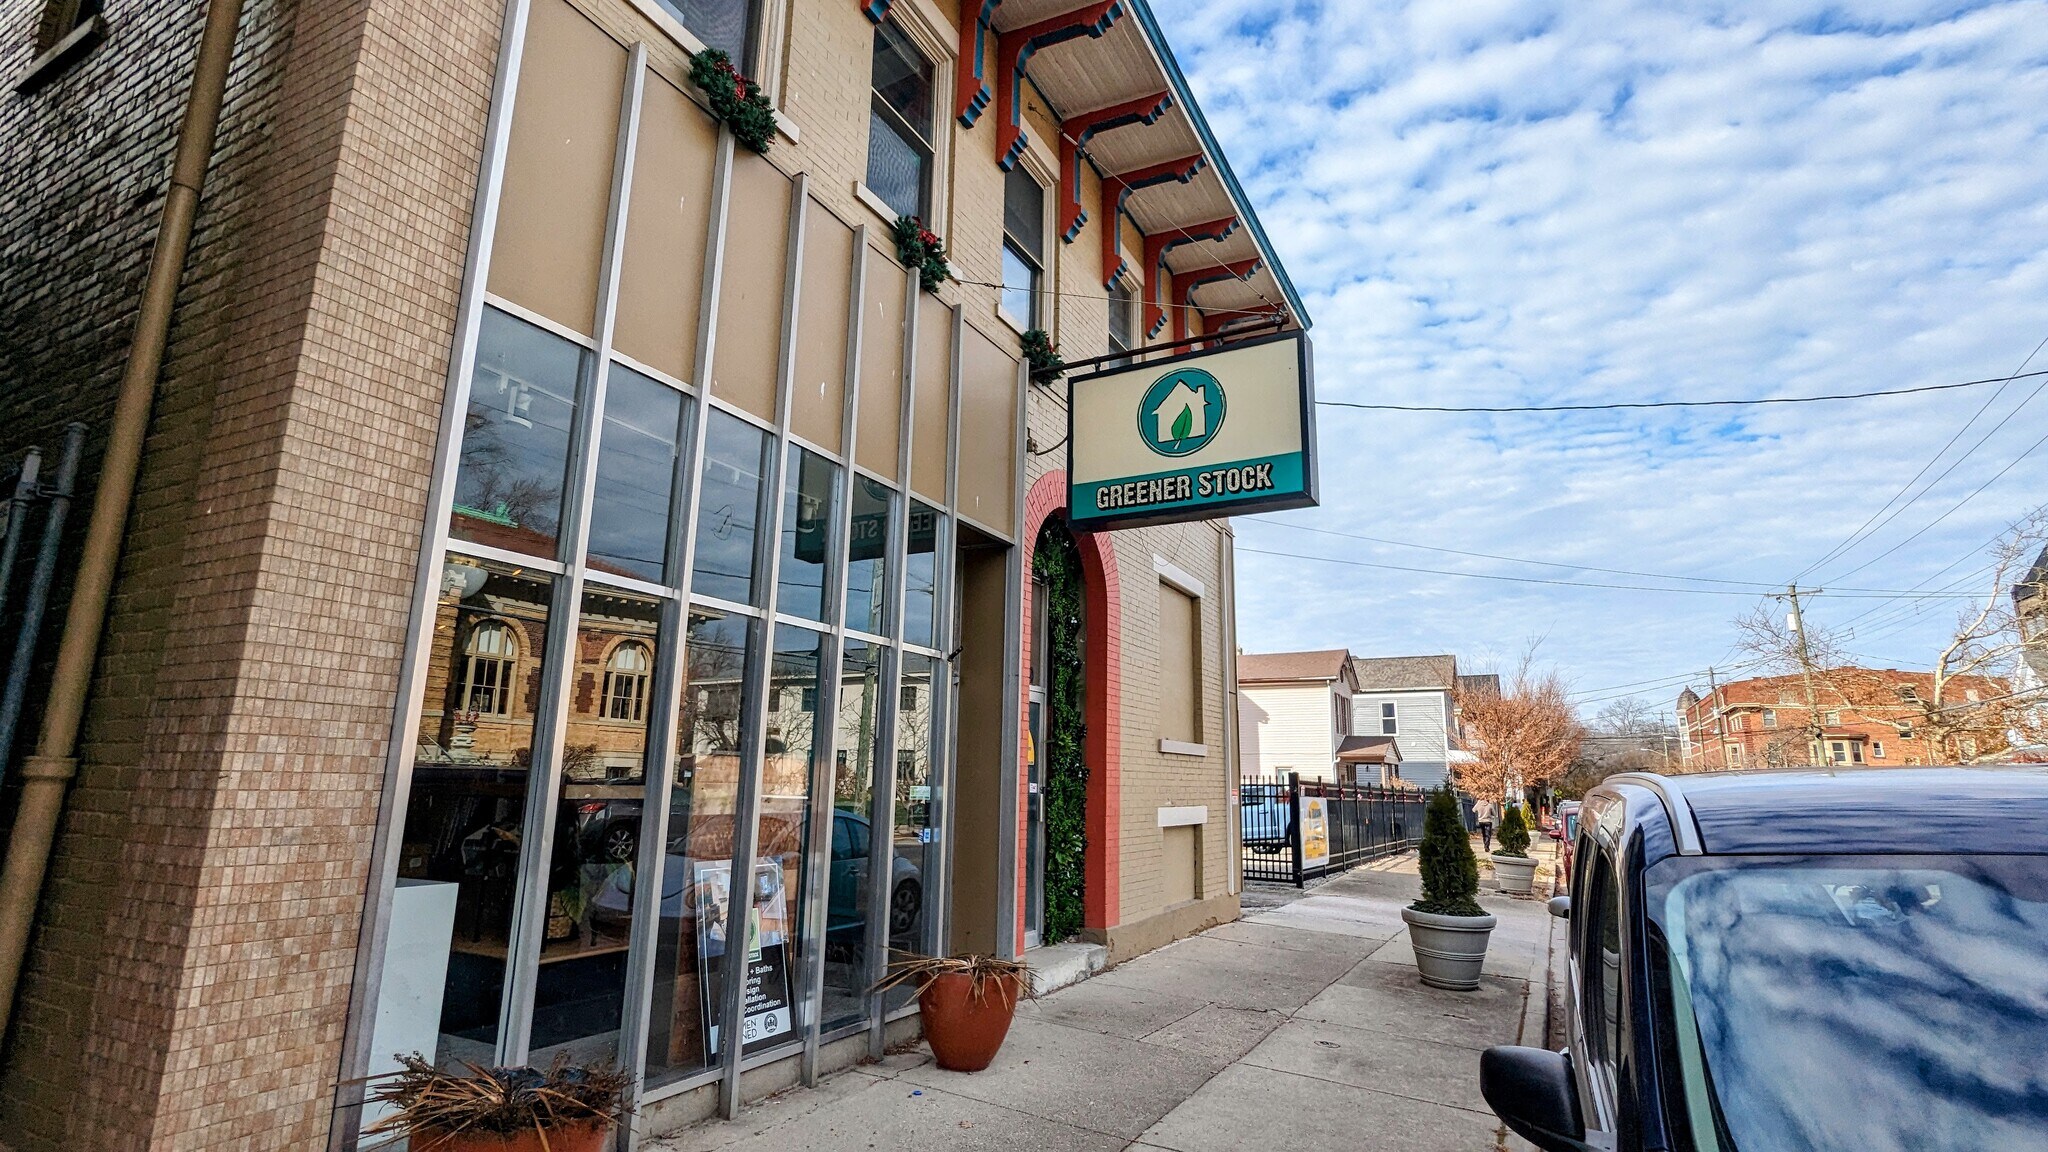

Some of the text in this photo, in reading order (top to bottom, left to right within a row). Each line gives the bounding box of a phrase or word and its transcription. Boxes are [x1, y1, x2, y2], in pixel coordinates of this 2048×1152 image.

[1096, 463, 1273, 510] GREENER STOCK
[755, 965, 773, 974] Baths
